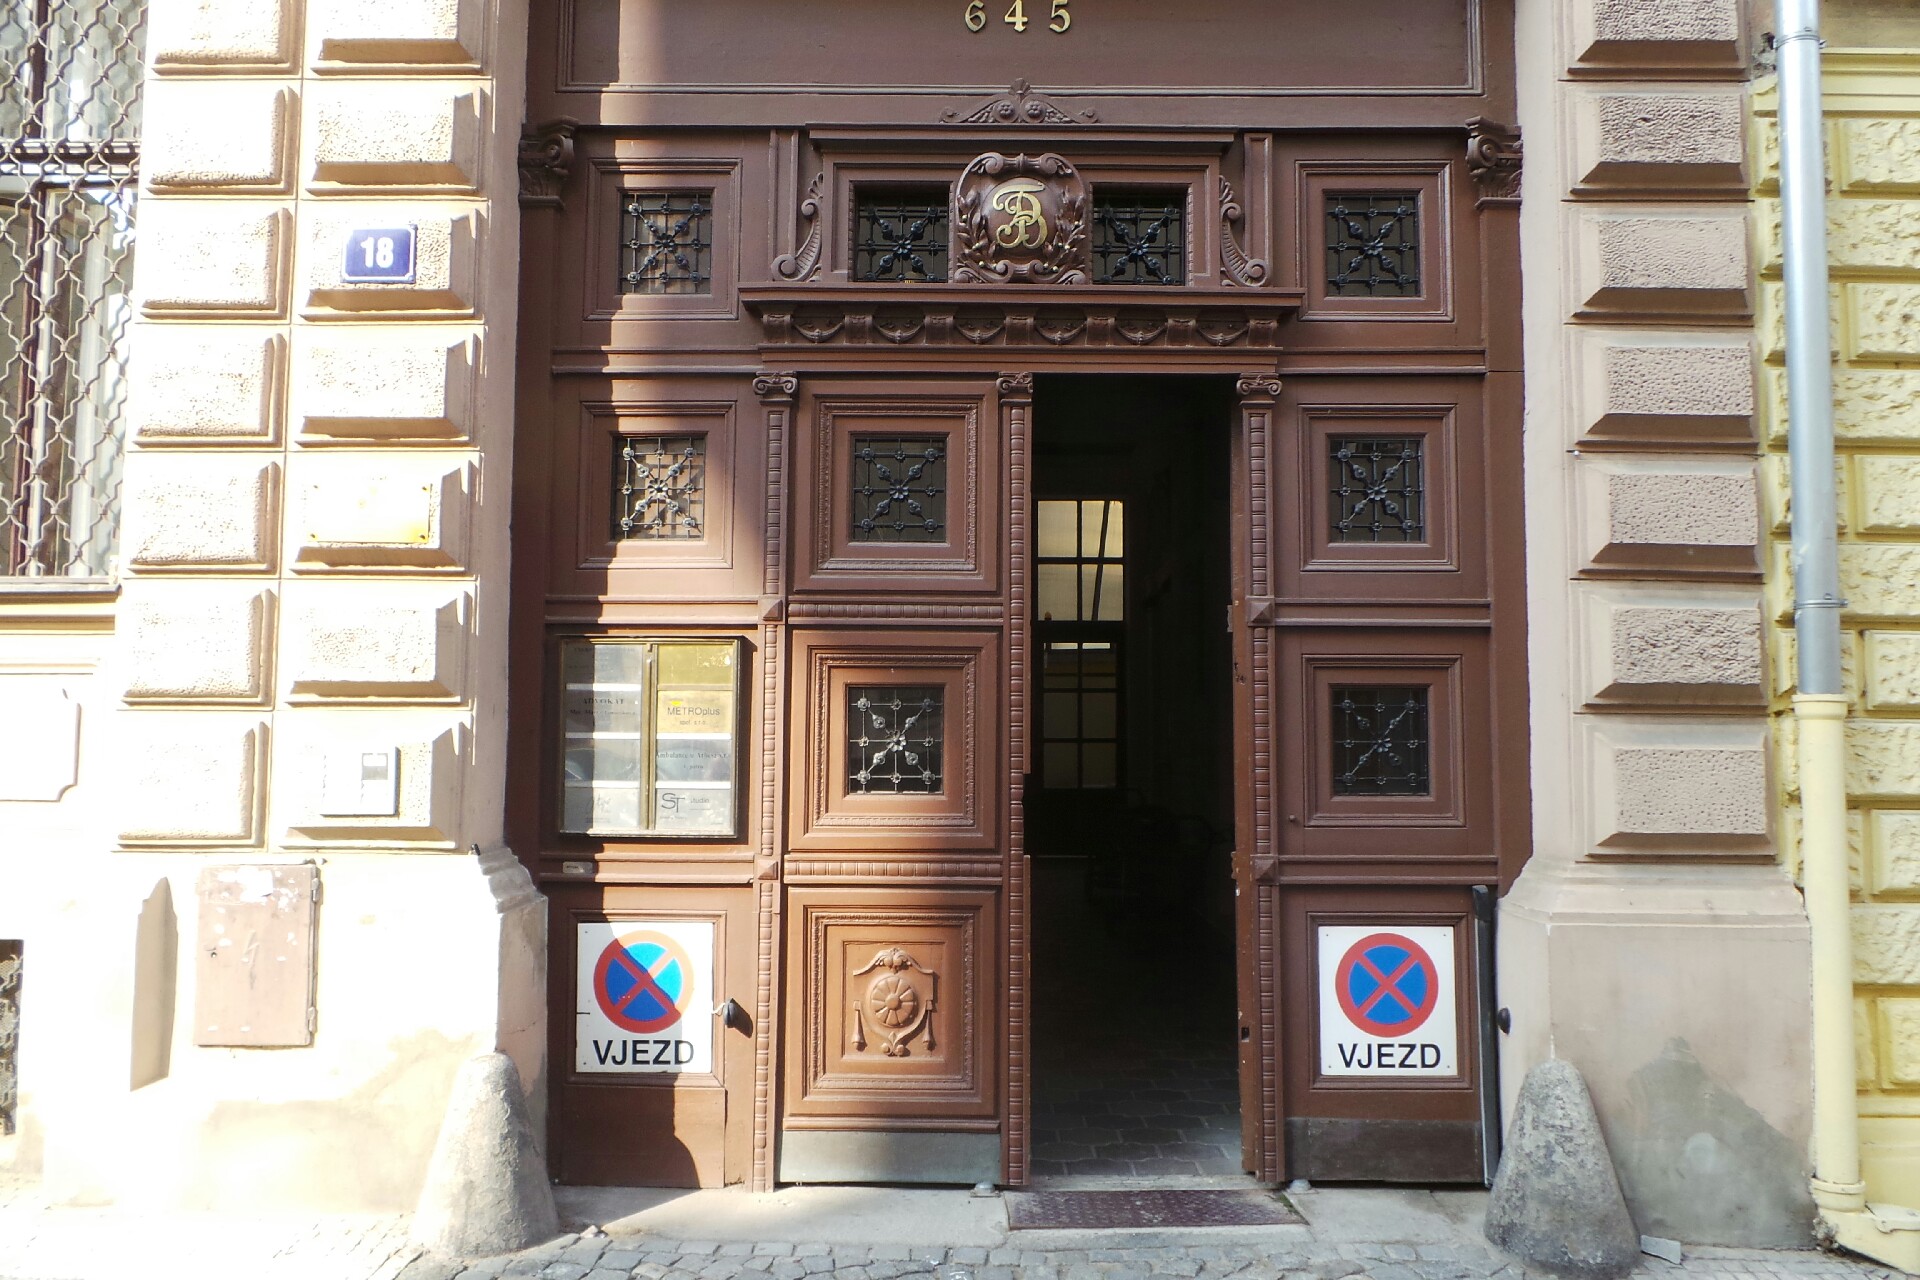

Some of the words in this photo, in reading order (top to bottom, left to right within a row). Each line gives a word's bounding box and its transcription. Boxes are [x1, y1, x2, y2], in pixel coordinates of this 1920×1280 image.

[360, 236, 394, 269] 18
[667, 707, 721, 717] METROplus
[661, 792, 685, 813] ST
[592, 1040, 694, 1065] VJEZD
[1337, 1043, 1441, 1068] VJEZD
